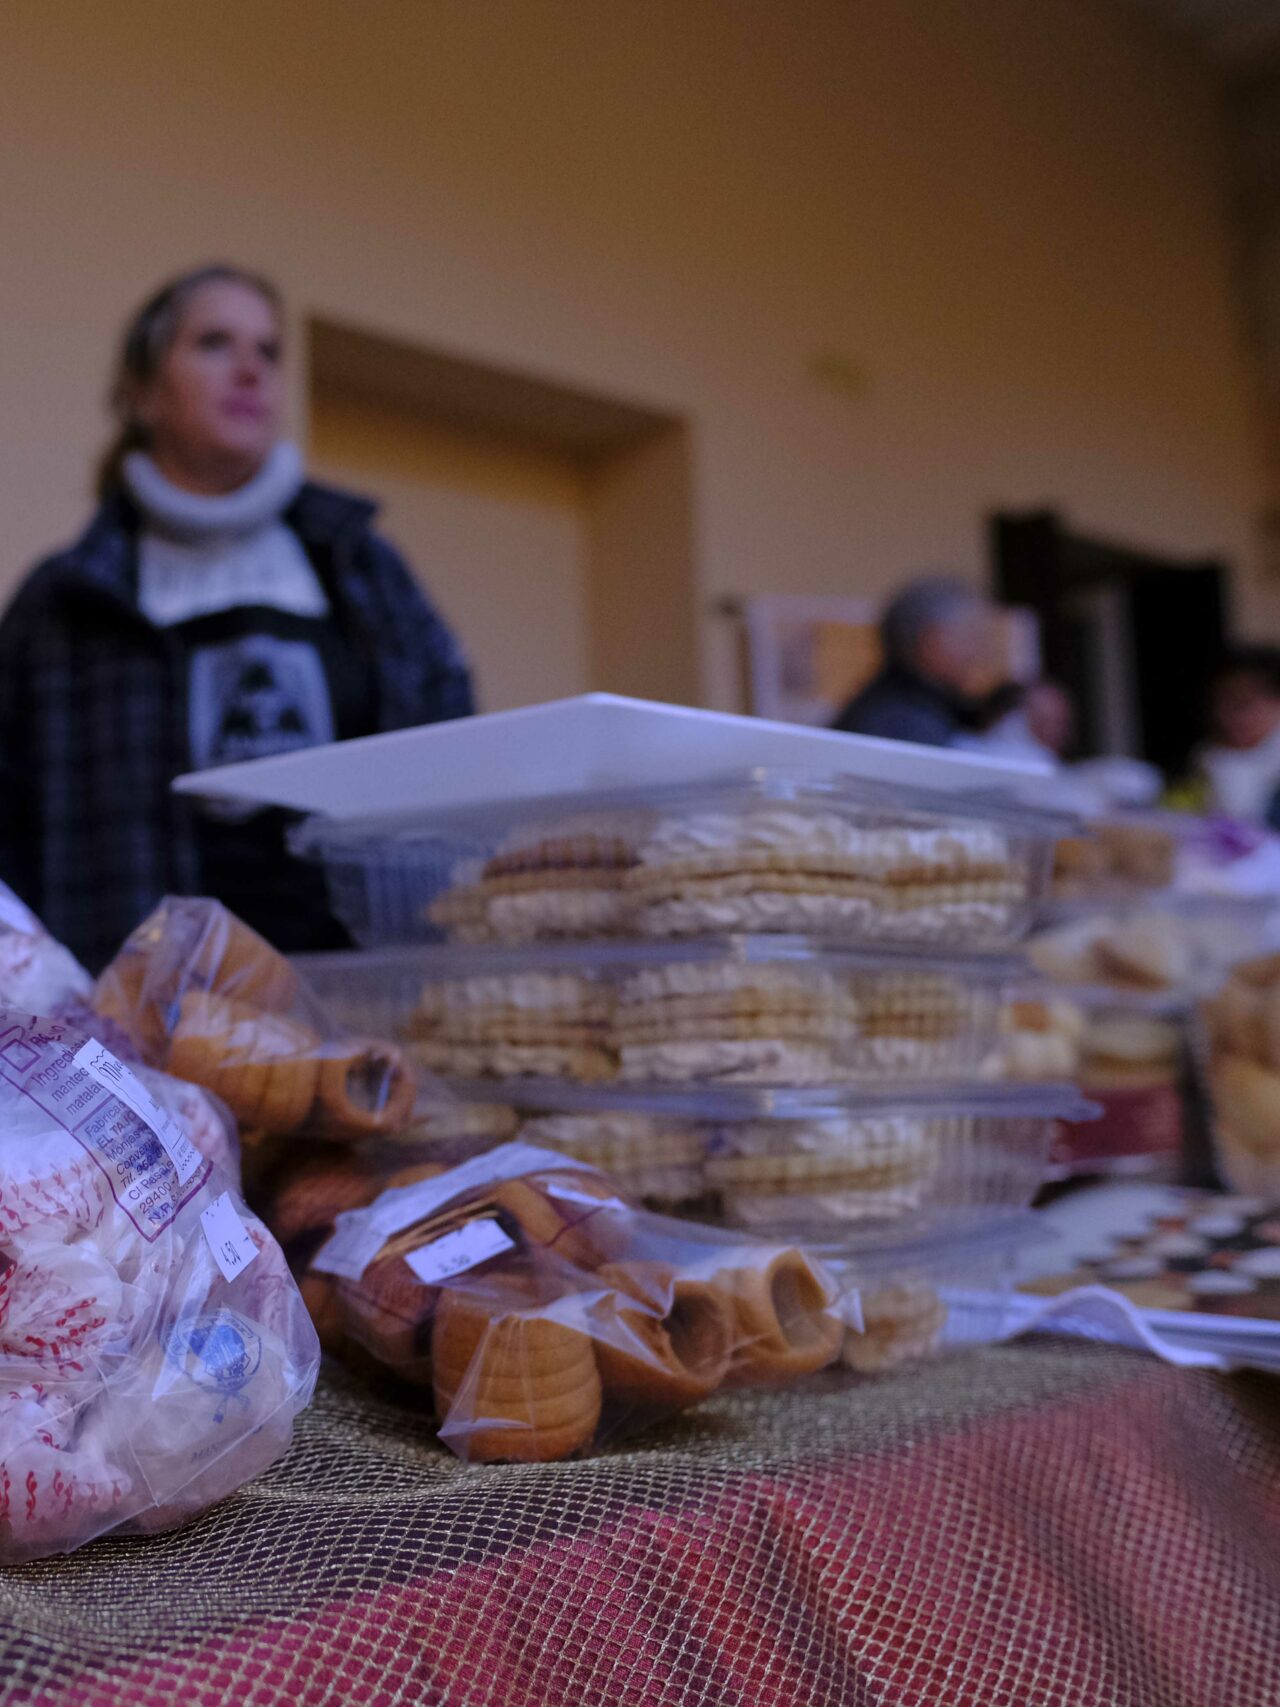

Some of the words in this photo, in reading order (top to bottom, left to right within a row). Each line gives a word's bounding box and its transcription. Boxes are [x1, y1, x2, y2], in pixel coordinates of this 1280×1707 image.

[97, 1134, 114, 1151] EL
[109, 1111, 138, 1136] TAJO
[105, 1129, 141, 1162] Monjas
[139, 1181, 172, 1215] 29400
